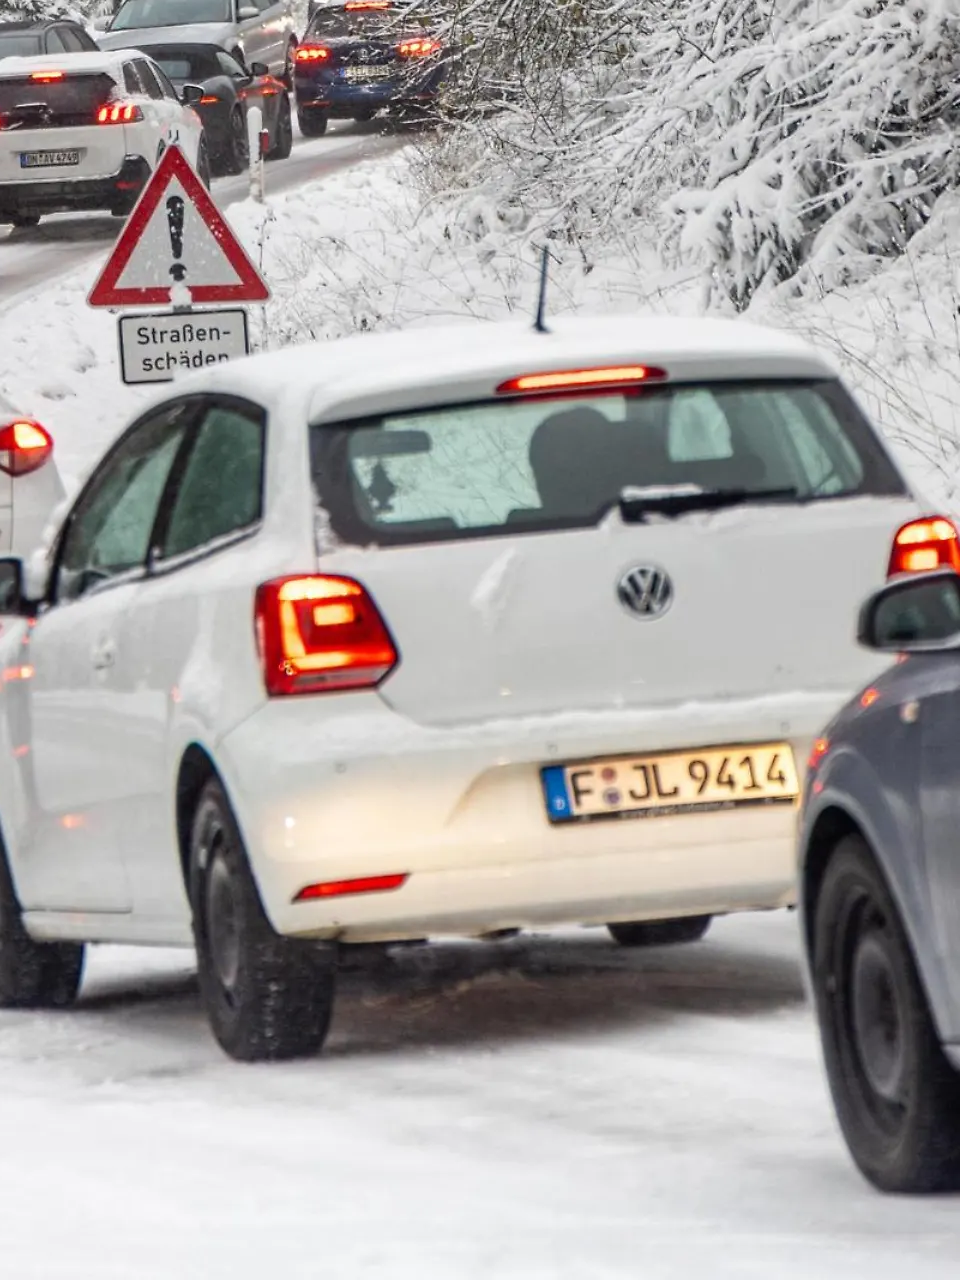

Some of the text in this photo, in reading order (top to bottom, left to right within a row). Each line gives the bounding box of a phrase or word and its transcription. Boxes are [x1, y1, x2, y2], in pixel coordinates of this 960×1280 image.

[136, 323, 231, 345] Straßen-
[570, 770, 594, 808] F
[628, 763, 680, 800] JL
[687, 753, 787, 796] 9414
